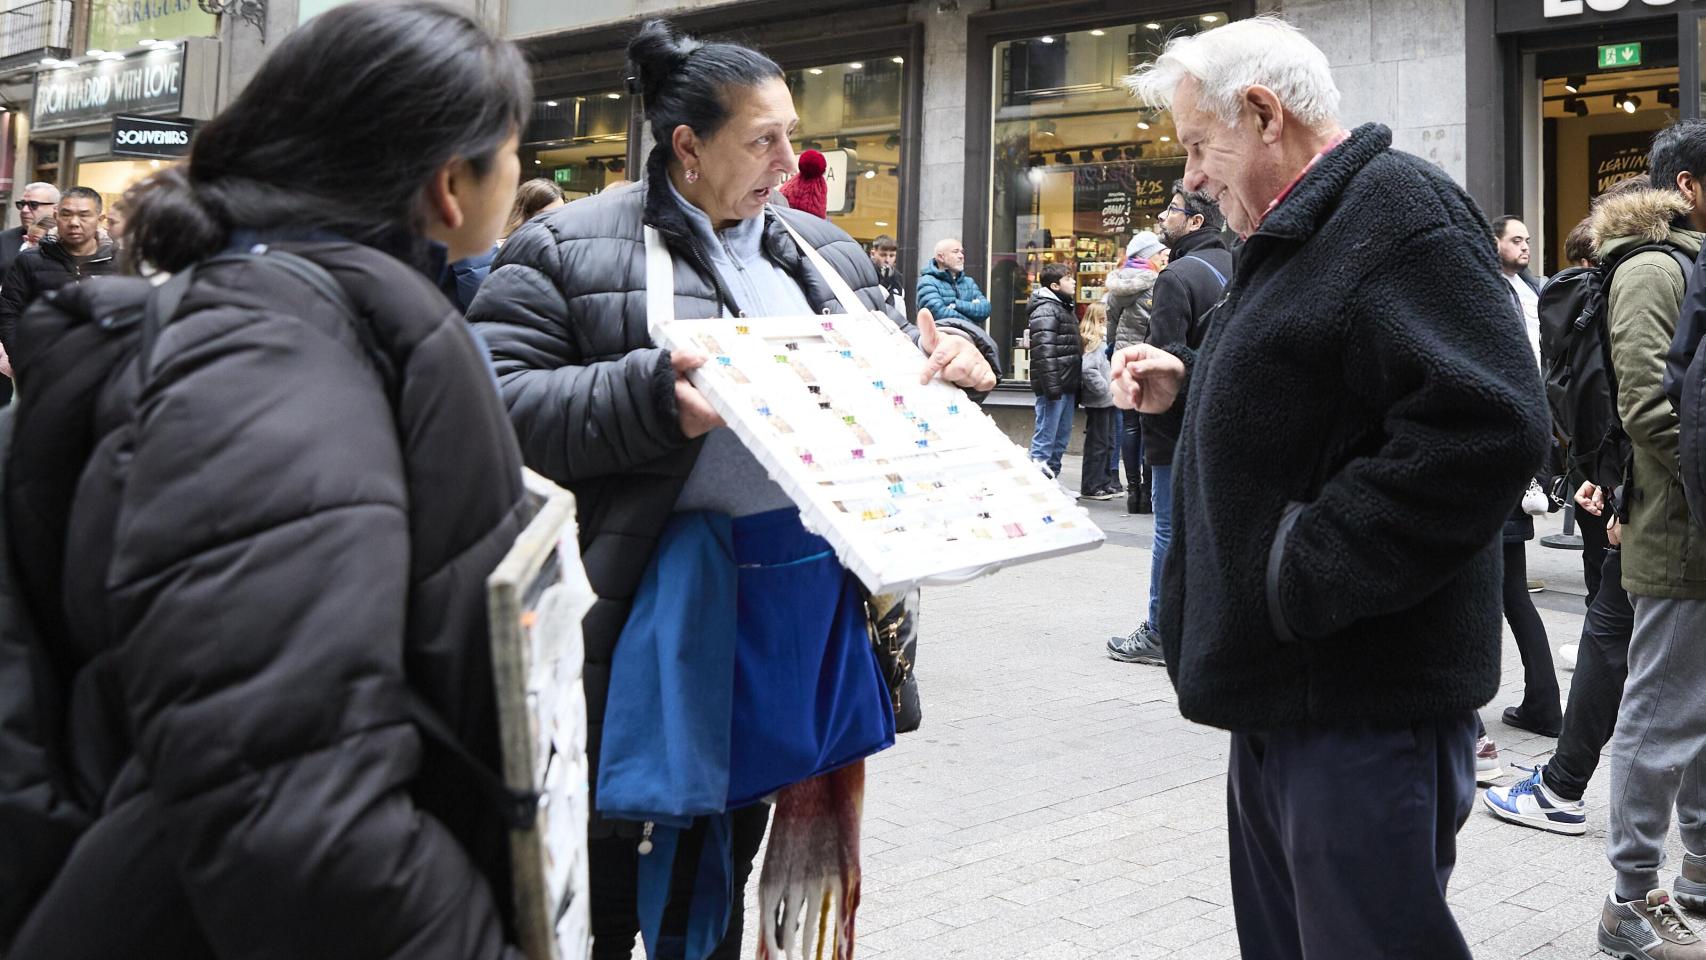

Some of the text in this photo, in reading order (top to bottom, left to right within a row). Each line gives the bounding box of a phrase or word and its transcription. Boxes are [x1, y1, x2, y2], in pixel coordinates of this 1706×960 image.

[68, 75, 111, 110] MADRID
[114, 69, 142, 101] WITH
[143, 62, 178, 98] LOVE
[116, 129, 188, 145] SOUVENIRS
